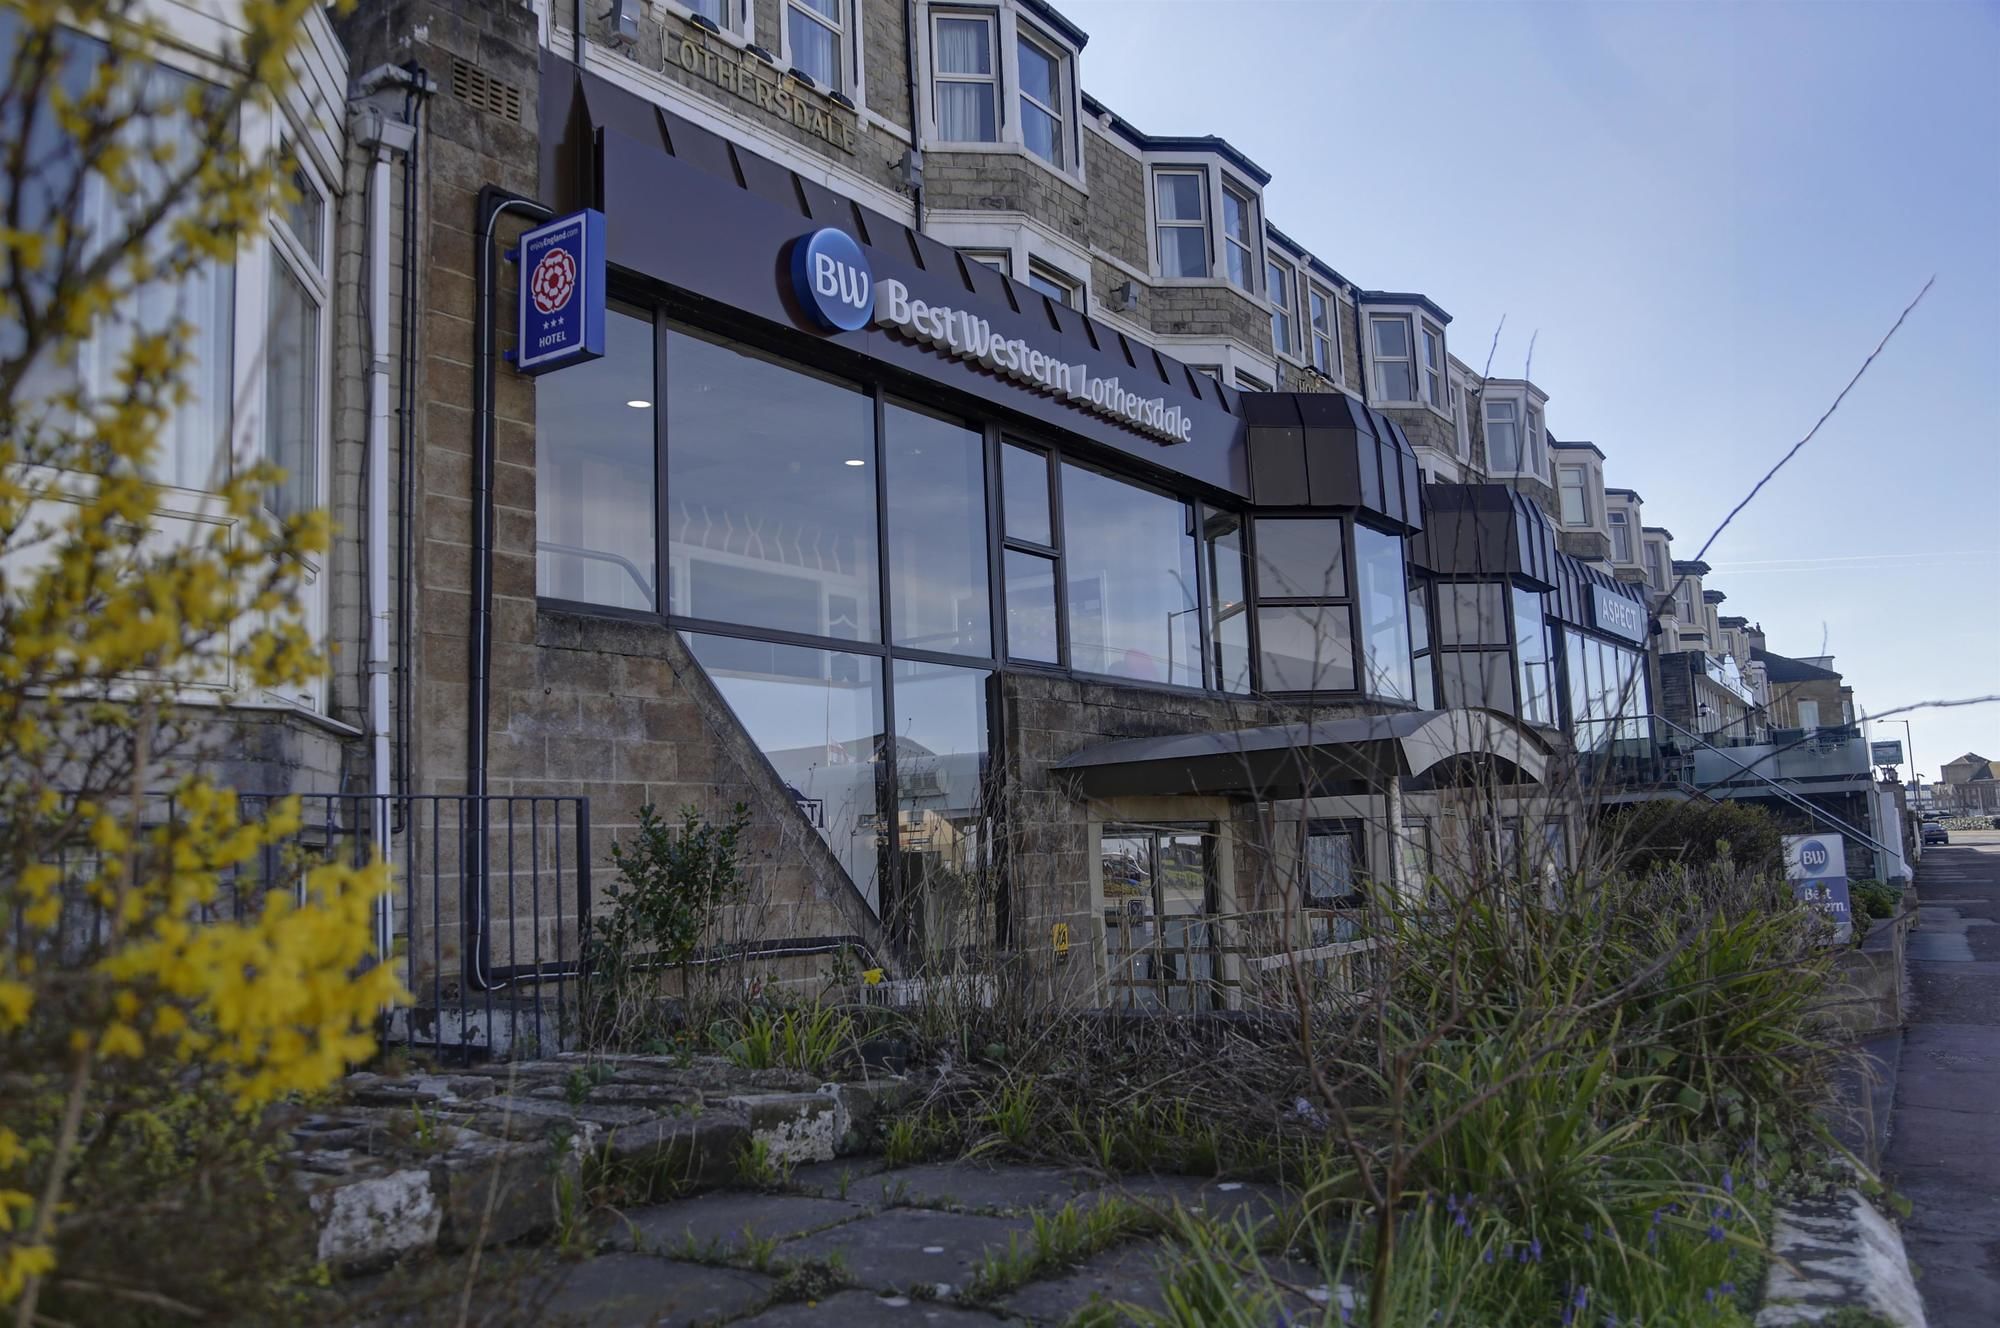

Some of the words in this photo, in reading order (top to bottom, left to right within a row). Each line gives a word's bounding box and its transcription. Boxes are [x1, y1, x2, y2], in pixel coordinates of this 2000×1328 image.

[664, 31, 856, 156] LOTHERSDALE
[530, 228, 579, 251] enjoyEngland.com
[815, 251, 870, 309] BW
[538, 330, 567, 348] HOTEL
[887, 278, 959, 348] Best
[961, 309, 1073, 394] Western
[1080, 363, 1192, 443] Lothersdale
[1602, 596, 1637, 632] ASPECT
[1802, 850, 1826, 865] BW
[1804, 887, 1832, 901] Bet
